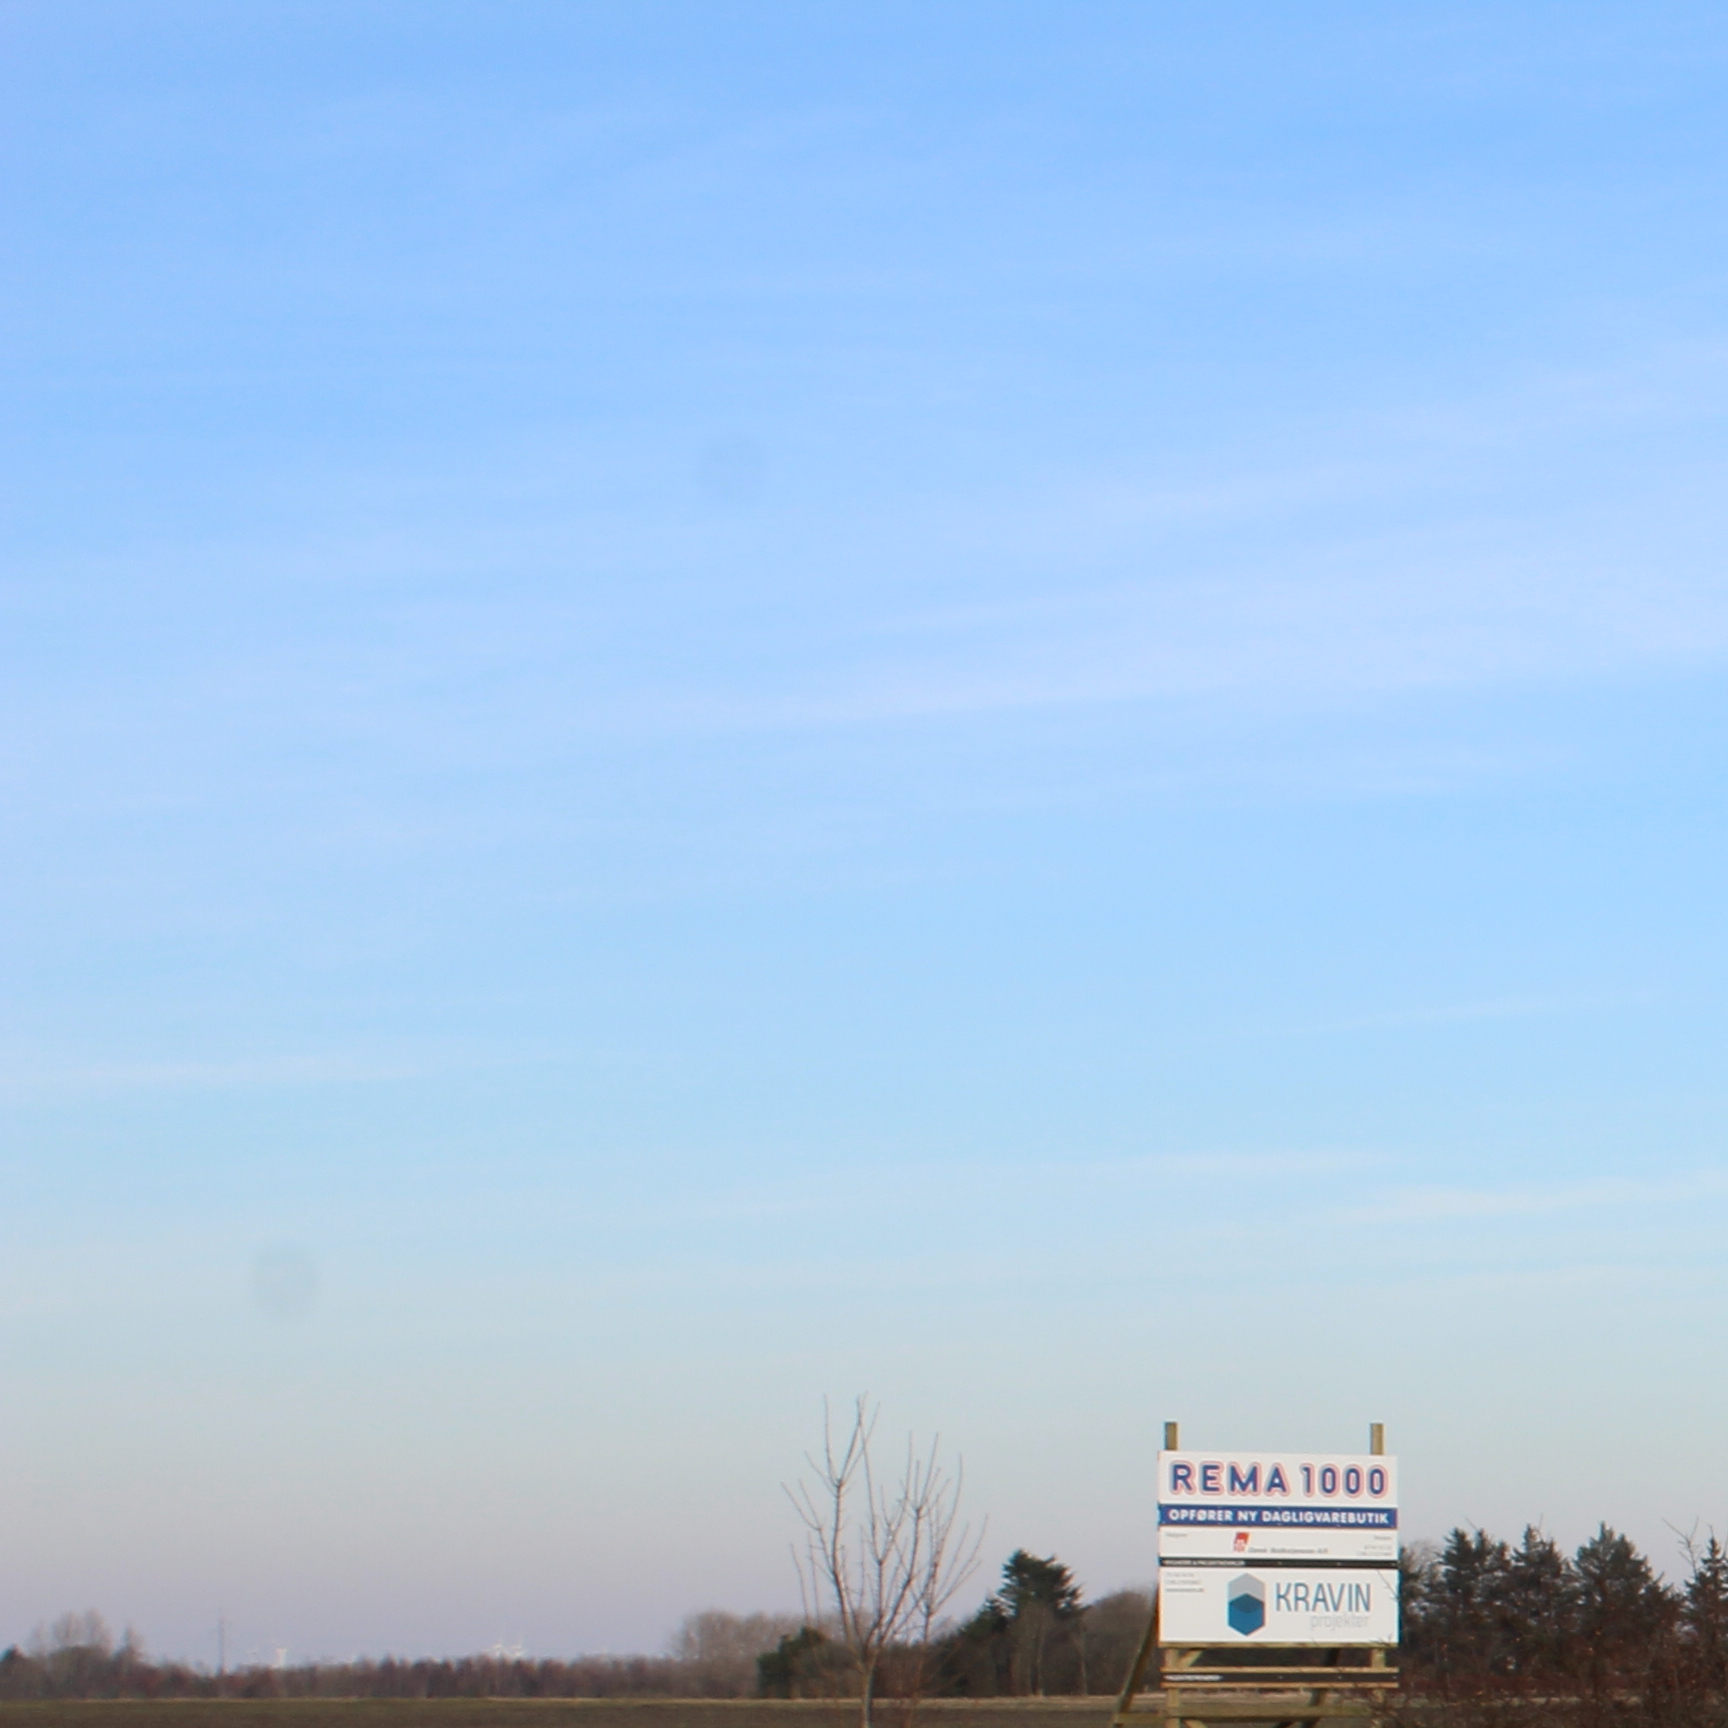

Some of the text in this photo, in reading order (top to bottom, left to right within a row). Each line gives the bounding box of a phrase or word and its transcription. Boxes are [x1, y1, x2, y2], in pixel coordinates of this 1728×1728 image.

[1171, 1462, 1387, 1496] REMA 1000
[1168, 1508, 1389, 1525] OPFØRER NY DAGLIGVAREBUTIK
[1275, 1582, 1371, 1612] KRAVIN
